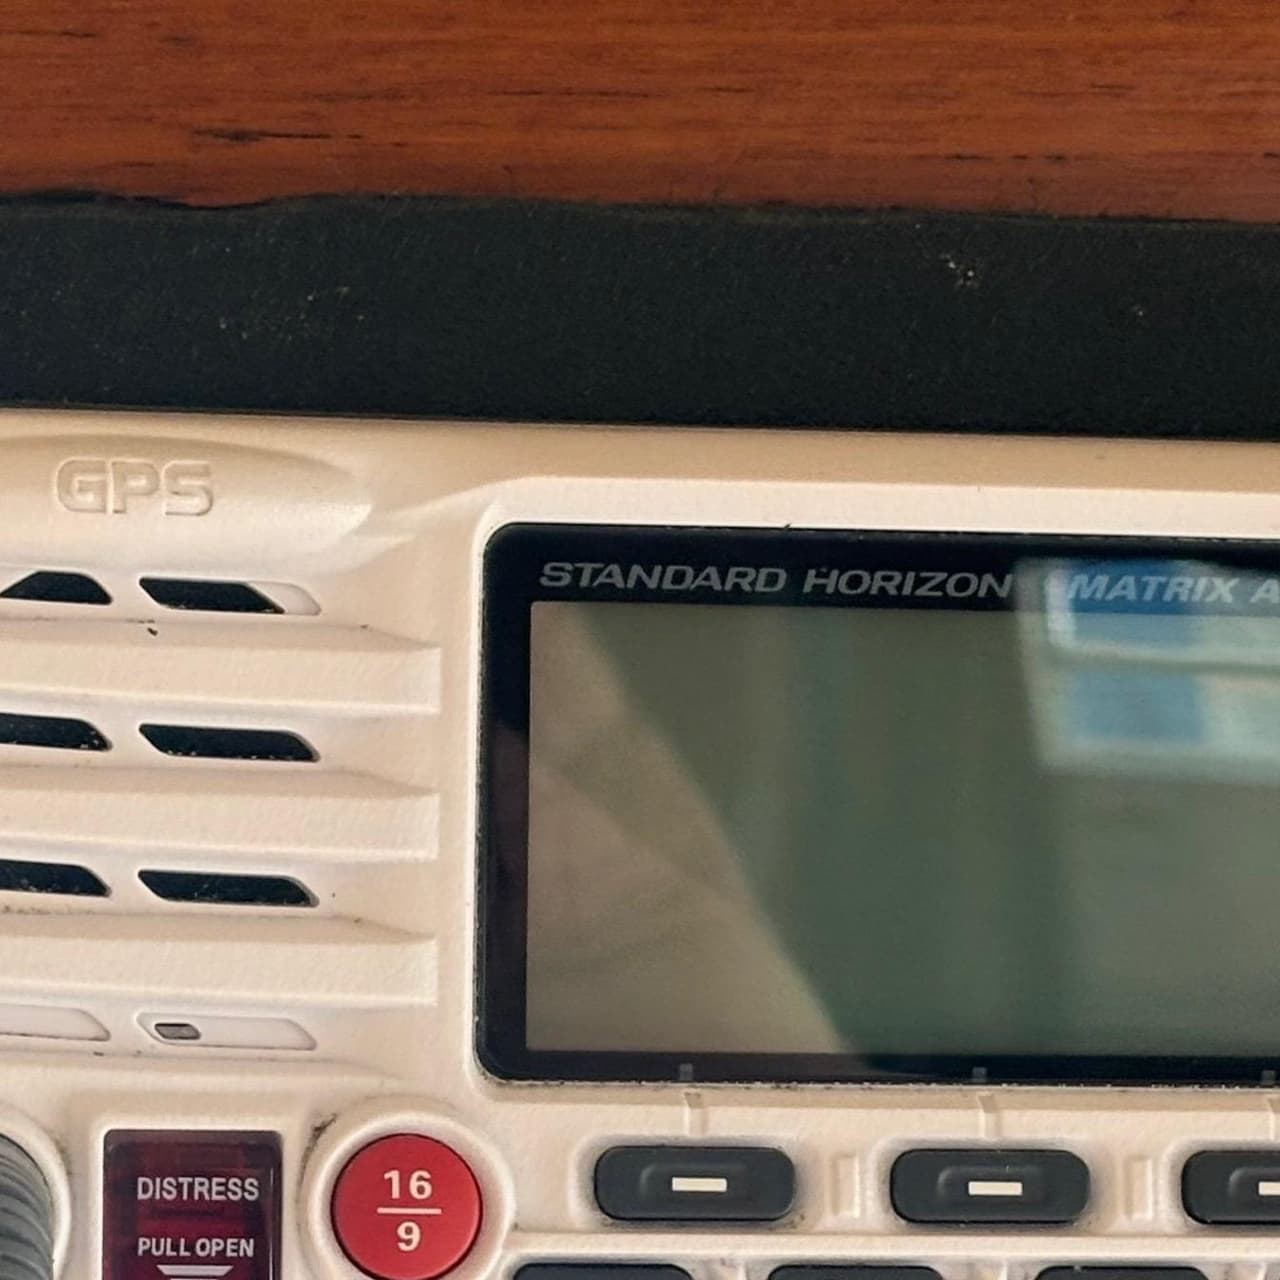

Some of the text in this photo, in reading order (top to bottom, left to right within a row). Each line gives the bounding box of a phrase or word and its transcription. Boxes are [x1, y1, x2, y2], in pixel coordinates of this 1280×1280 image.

[53, 456, 215, 517] GPS
[539, 561, 787, 594] STANDARD
[802, 566, 1017, 599] HORIZON
[1066, 573, 1240, 604] MATRIX
[136, 1175, 260, 1202] DISTRESS
[382, 1169, 433, 1200] 16
[136, 1237, 255, 1259] PULL OPEN
[395, 1220, 422, 1253] 9
